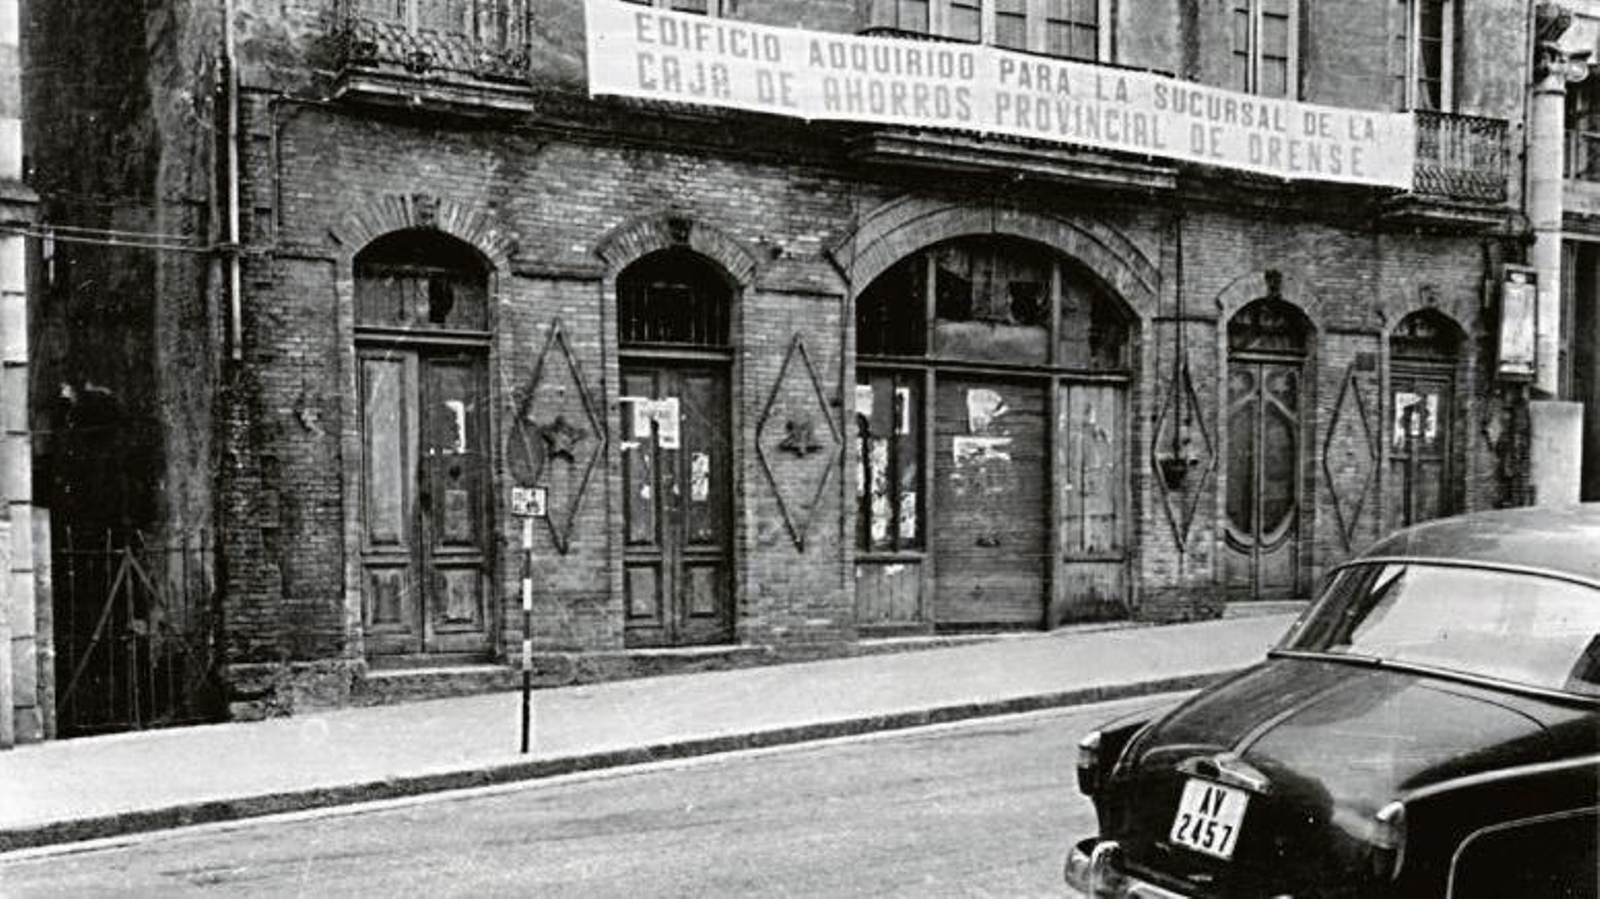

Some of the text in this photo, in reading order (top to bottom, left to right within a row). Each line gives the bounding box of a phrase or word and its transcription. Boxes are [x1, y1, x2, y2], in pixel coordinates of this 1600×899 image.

[635, 12, 781, 63] EDIFICIO
[999, 58, 1070, 96] PARA
[1096, 75, 1129, 103] LA
[1154, 82, 1286, 132] SUCURSAL
[1304, 112, 1332, 139] DE
[1349, 115, 1375, 142] LA
[637, 52, 1365, 177] CAJA DE AHORROS PROVINCIAL DE ORENSE
[1176, 813, 1233, 853] 2457
[1199, 786, 1227, 818] AV
